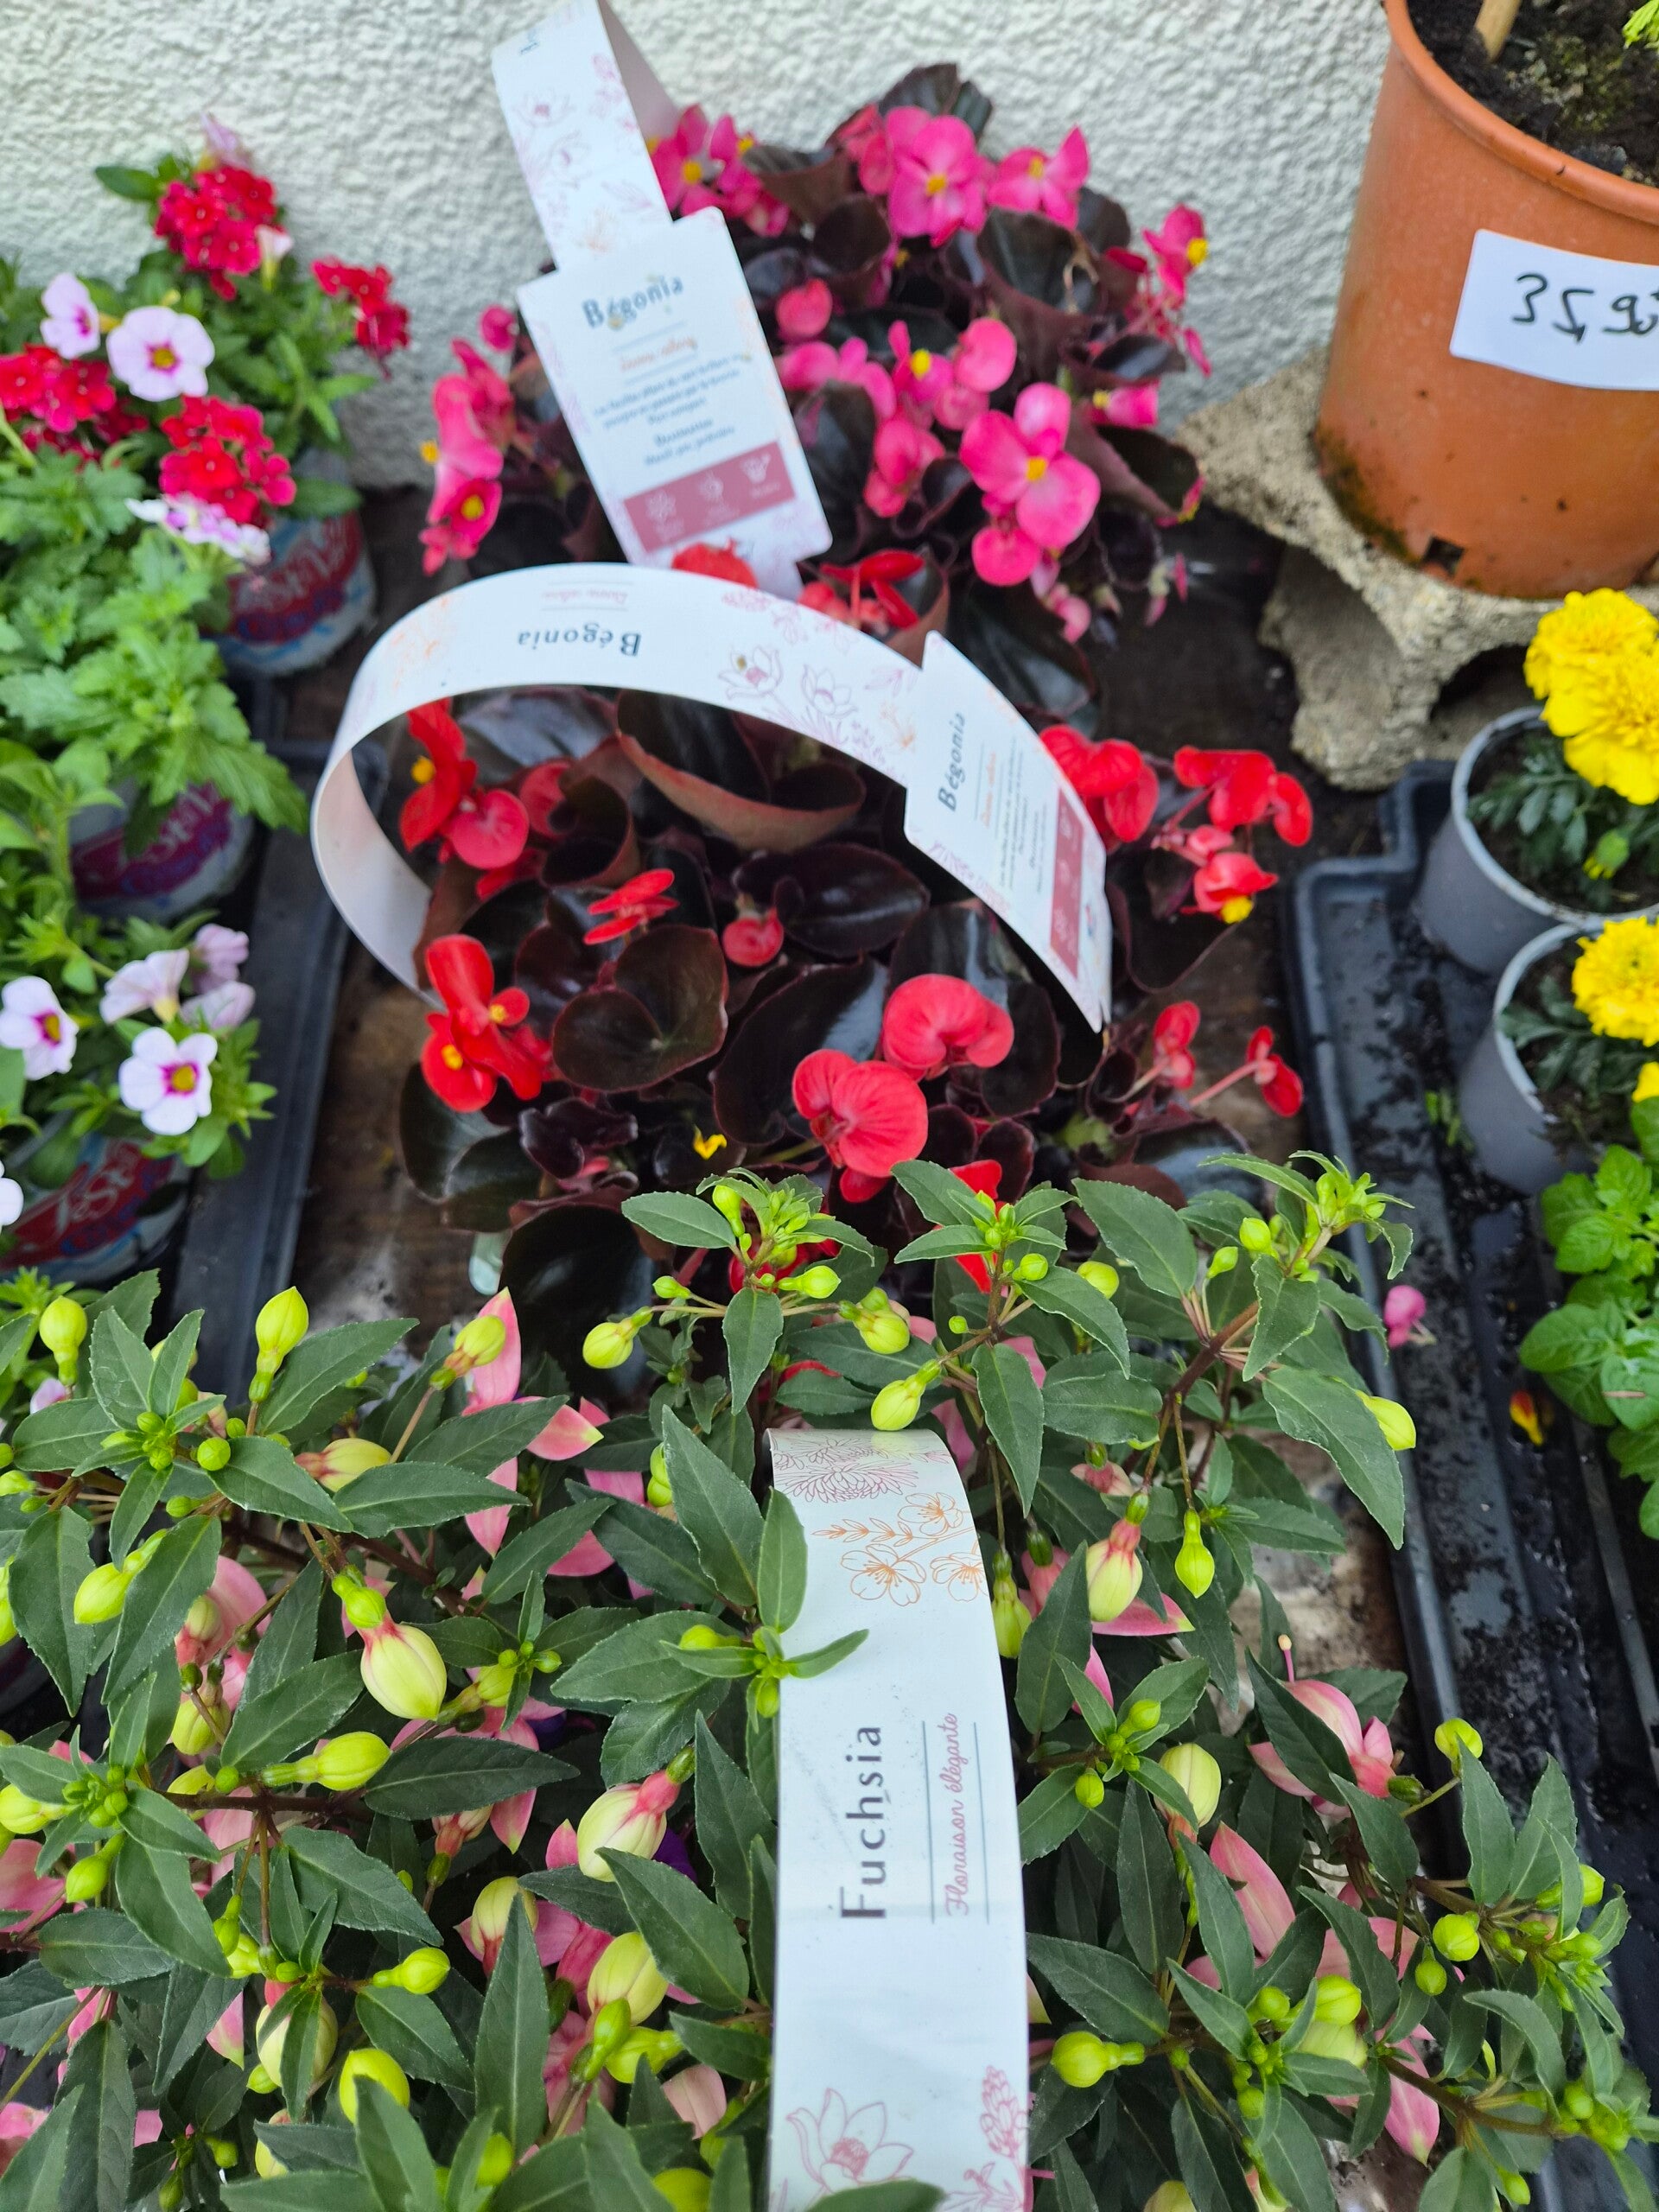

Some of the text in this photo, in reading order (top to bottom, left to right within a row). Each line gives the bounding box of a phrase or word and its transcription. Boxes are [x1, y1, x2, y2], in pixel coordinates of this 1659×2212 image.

[518, 621, 642, 658] Bégonia
[938, 712, 966, 813] Bégonia
[840, 1727, 887, 1919] Fuchsia
[938, 1713, 969, 1916] Floraison élégante
